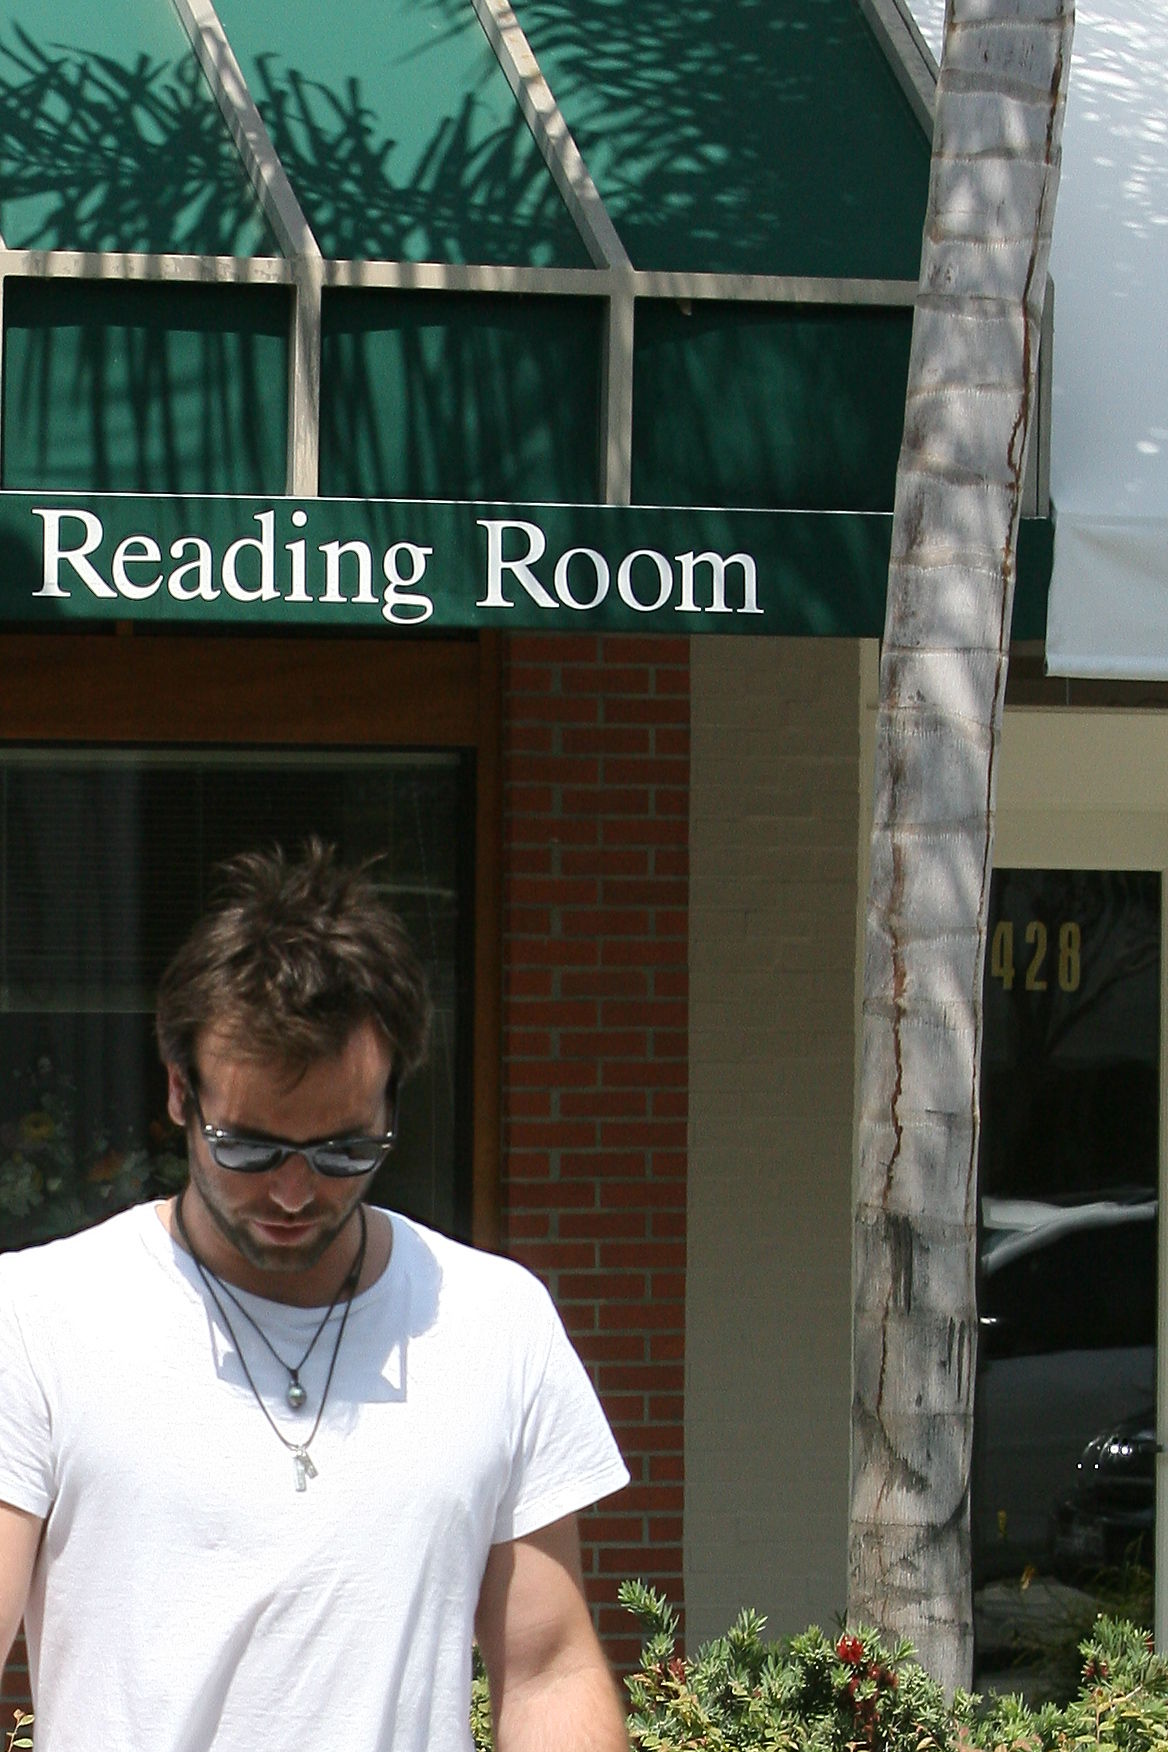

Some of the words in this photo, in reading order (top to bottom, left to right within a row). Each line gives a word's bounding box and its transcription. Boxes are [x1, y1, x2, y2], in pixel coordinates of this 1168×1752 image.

[32, 507, 434, 625] Reading
[476, 518, 765, 614] Room
[991, 920, 1081, 993] 428
